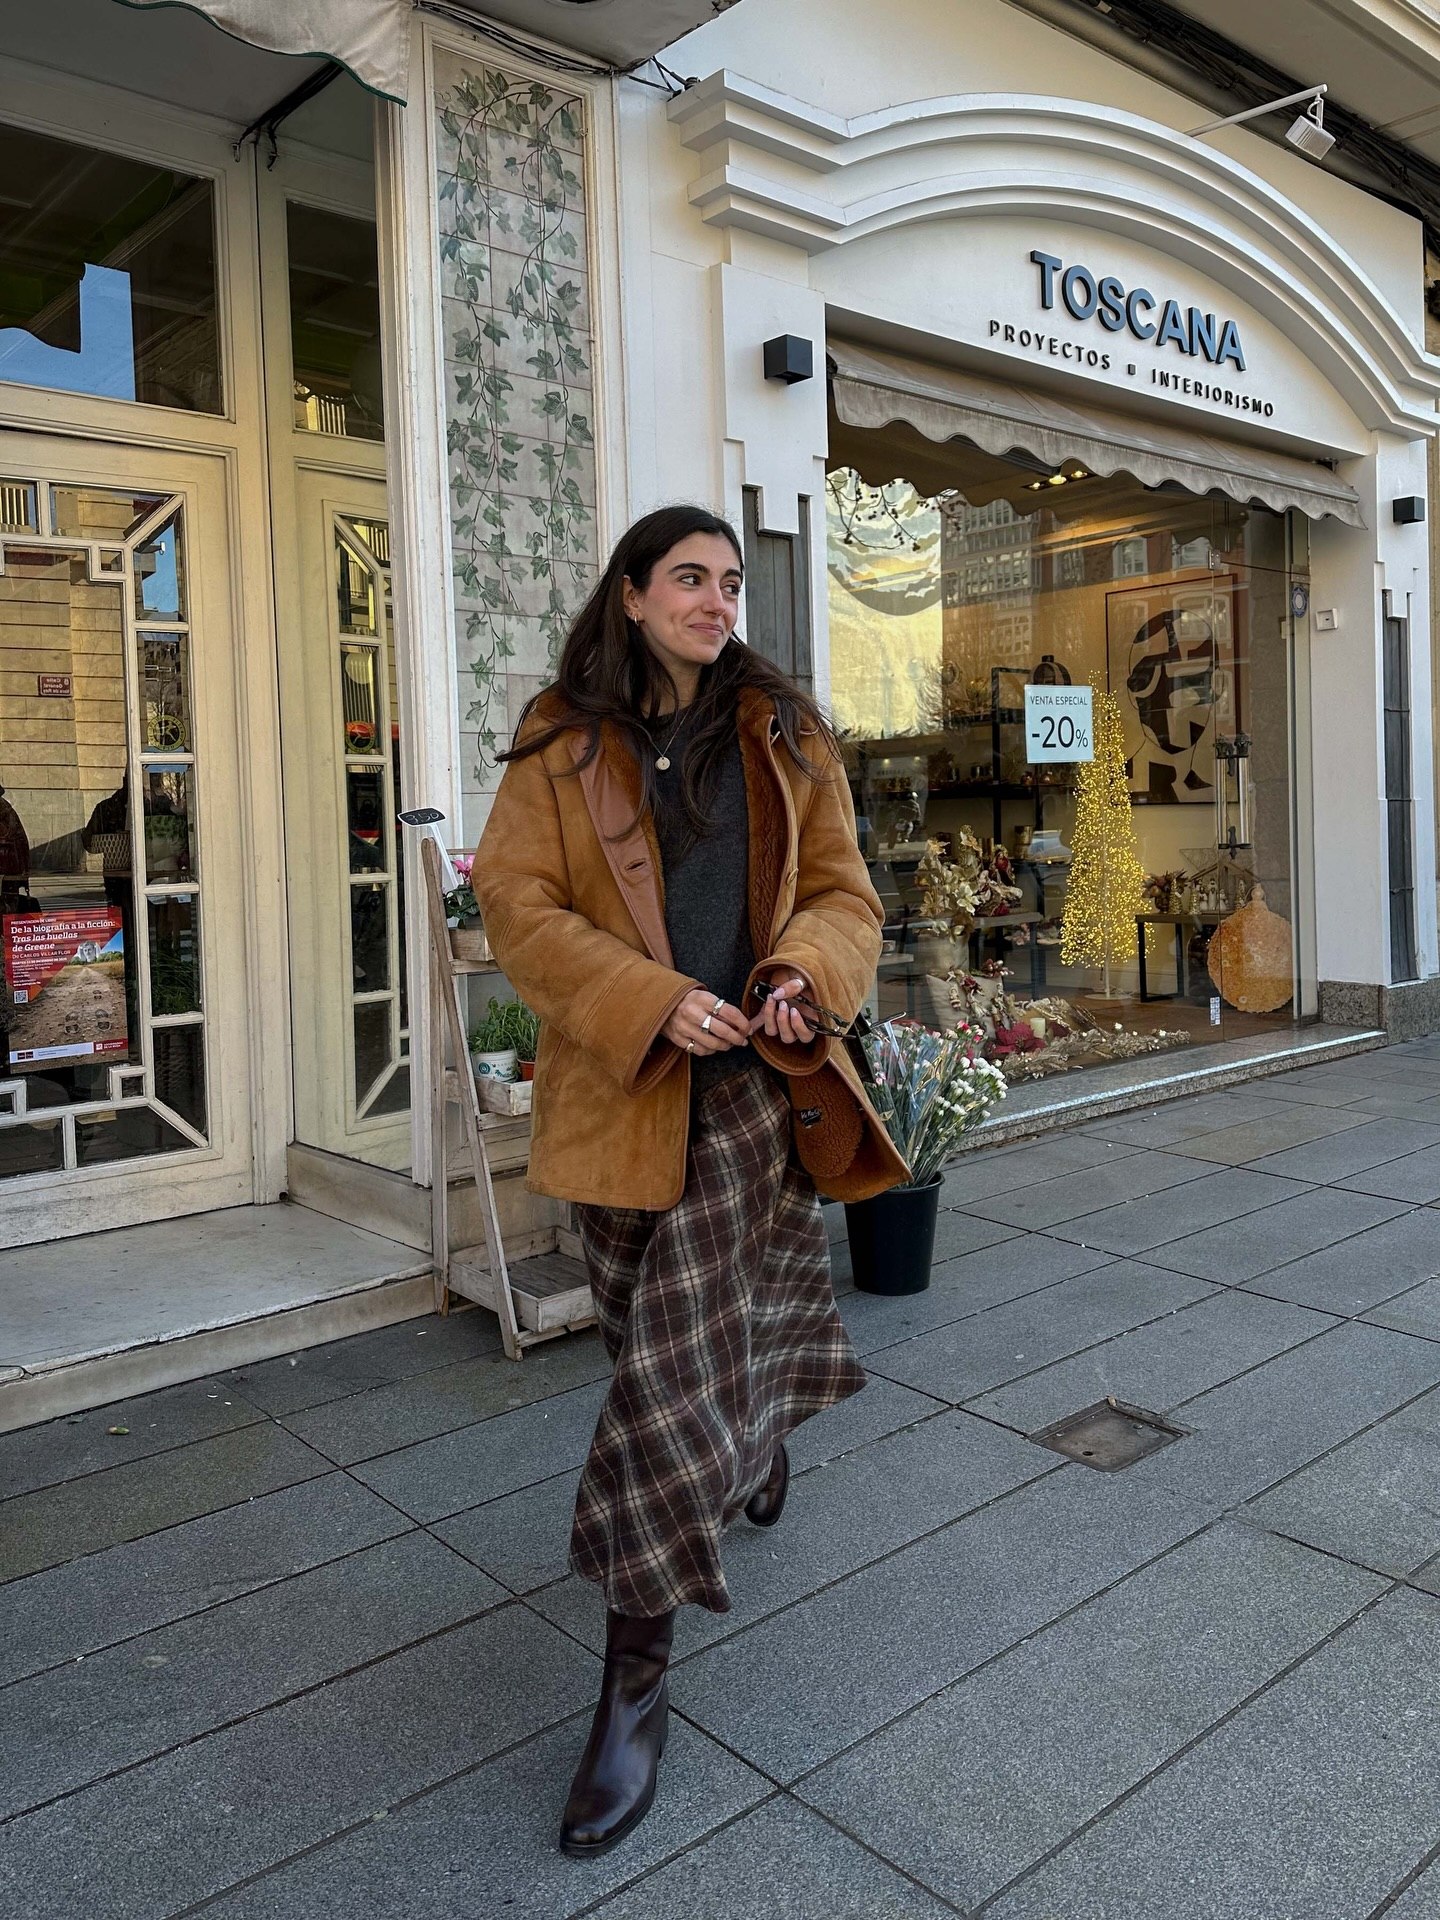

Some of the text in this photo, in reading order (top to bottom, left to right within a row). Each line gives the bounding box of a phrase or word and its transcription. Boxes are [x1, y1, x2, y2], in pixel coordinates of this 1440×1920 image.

[1030, 250, 1246, 372] TOSCANA
[989, 319, 1274, 417] PROYECTOS INTERIORISMO
[1030, 695, 1088, 706] VENTA ESPECIAL
[1031, 715, 1088, 748] -20%
[11, 926, 23, 934] De
[24, 925, 32, 933] la
[33, 922, 70, 933] biografía
[77, 921, 86, 929] la
[87, 919, 116, 929] ficción:
[12, 931, 78, 943] Tras las huellas
[12, 943, 55, 952] de Greene
